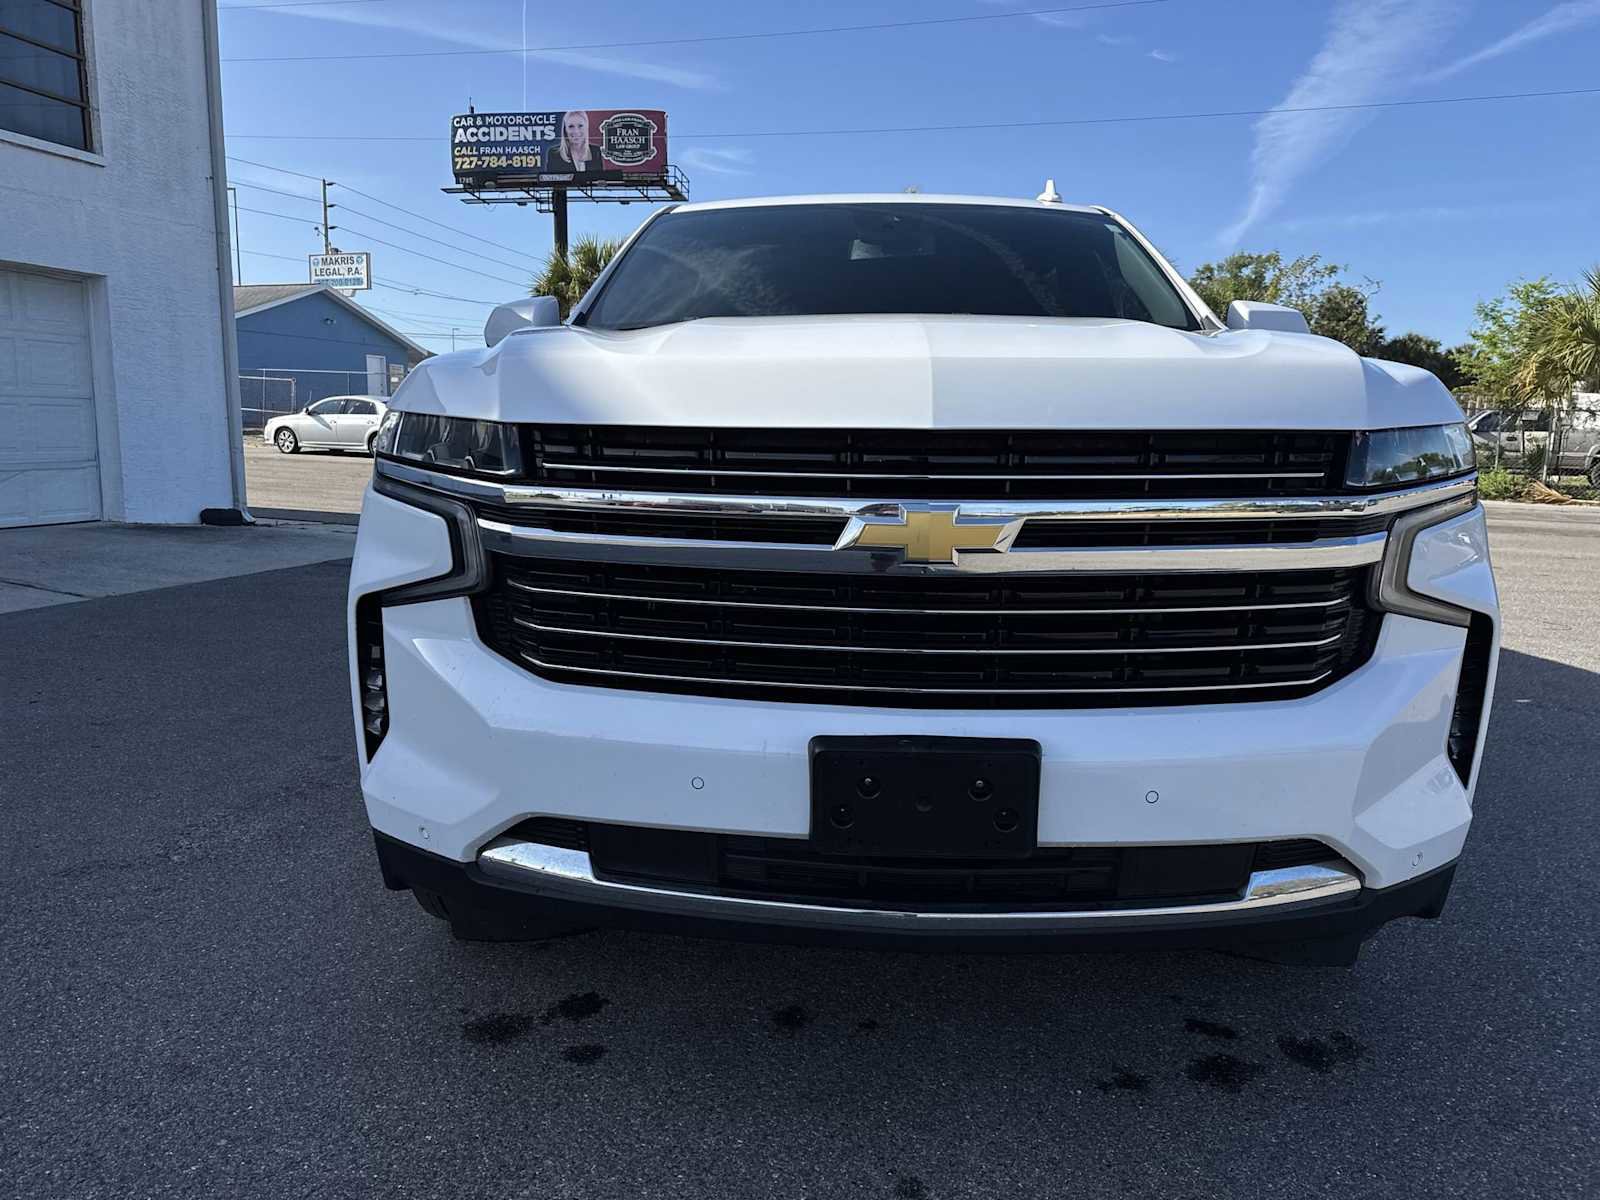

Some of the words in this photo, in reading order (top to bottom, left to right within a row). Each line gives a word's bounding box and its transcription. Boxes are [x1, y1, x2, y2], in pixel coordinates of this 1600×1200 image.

[453, 117, 474, 127] CAR
[476, 117, 483, 125] &
[486, 115, 556, 125] MOTORCYCLE
[454, 125, 556, 143] ACCIDENTS
[616, 128, 639, 136] FRAN
[610, 136, 645, 144] HAASCH
[454, 146, 478, 156] CALL
[480, 146, 503, 154] FRAN
[505, 145, 541, 154] HAASCH
[454, 155, 541, 170] 727-784-8191
[321, 256, 355, 266] MAKRIS
[347, 266, 363, 276] P.A.
